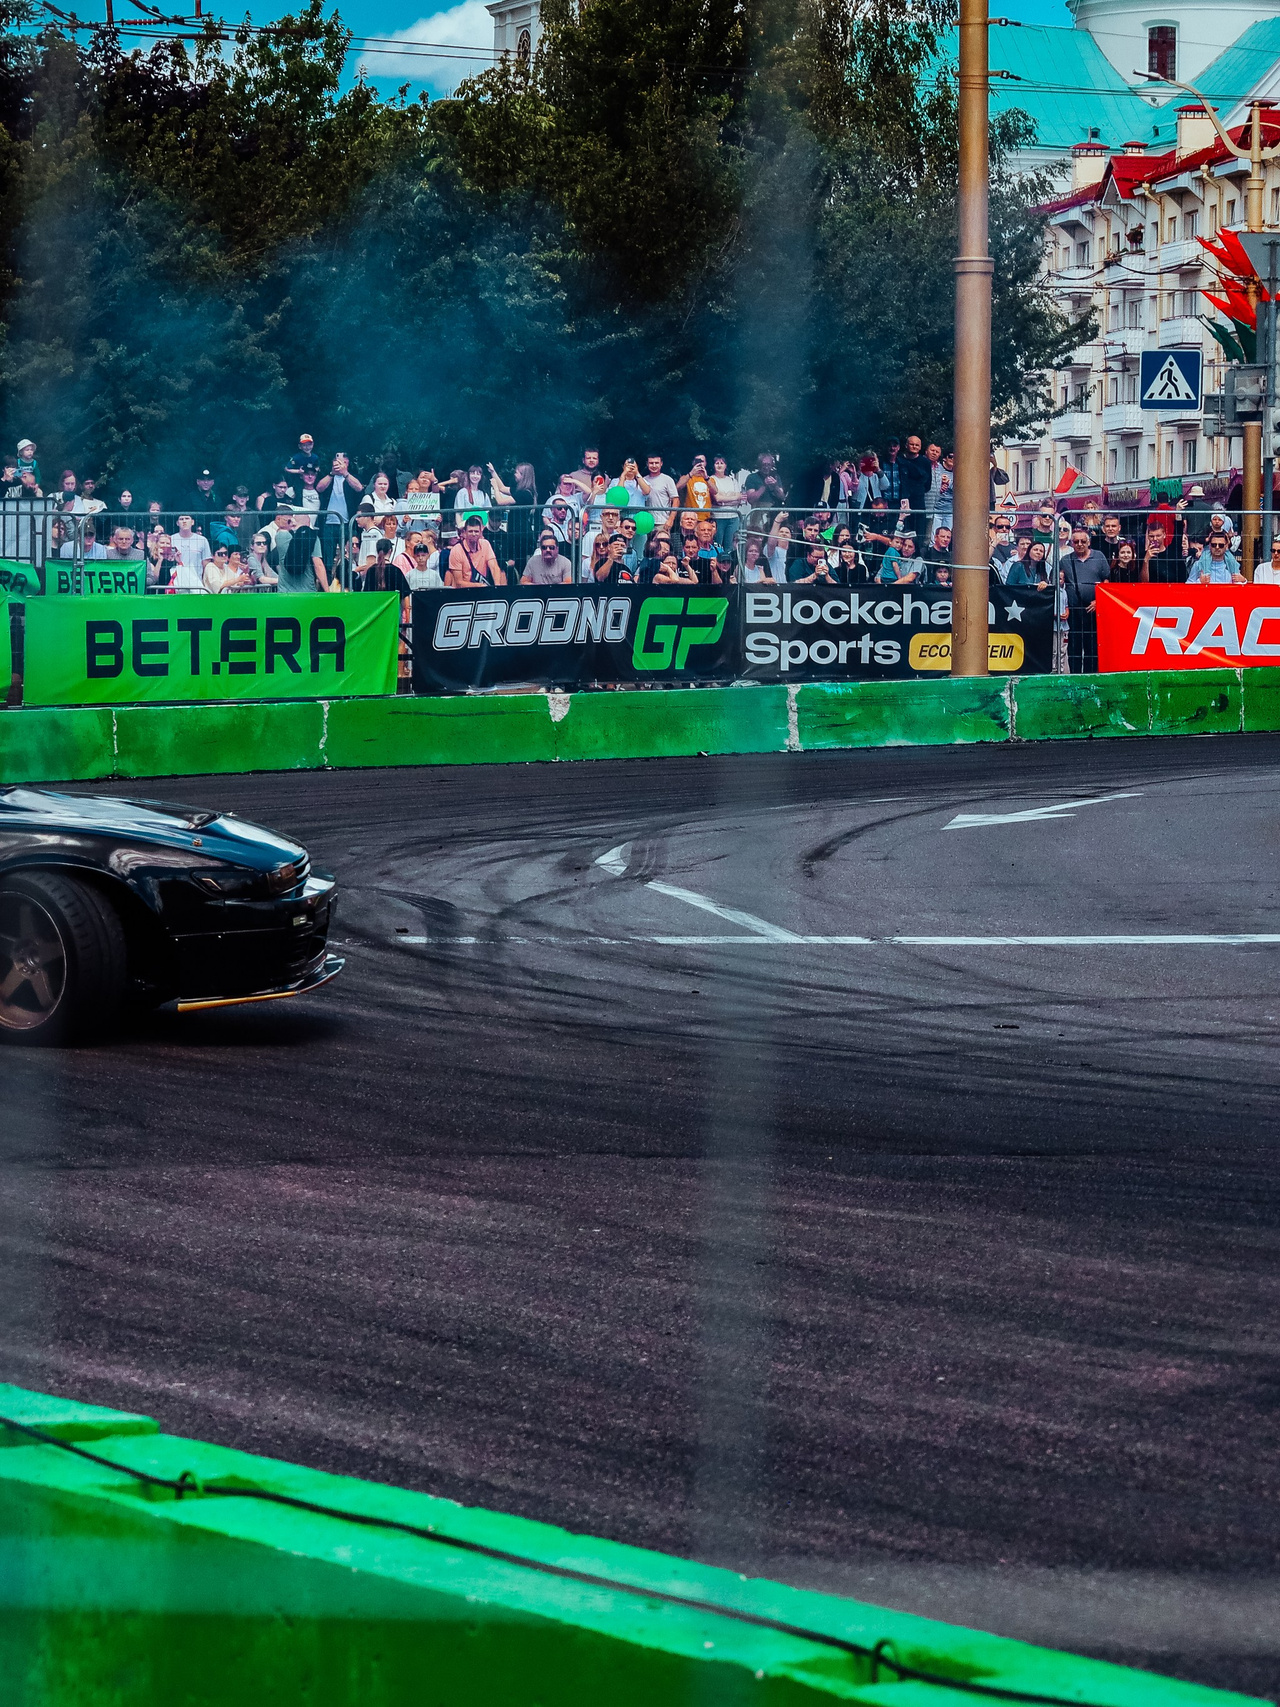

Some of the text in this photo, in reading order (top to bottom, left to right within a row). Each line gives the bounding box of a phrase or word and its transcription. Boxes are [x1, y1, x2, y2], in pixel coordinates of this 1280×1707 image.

[58, 571, 138, 594] BET.ERA
[746, 593, 996, 625] Blockcha
[86, 616, 346, 679] BET.ERA
[432, 597, 729, 670] GRODNO GP
[745, 631, 1015, 671] Sports ECOEM
